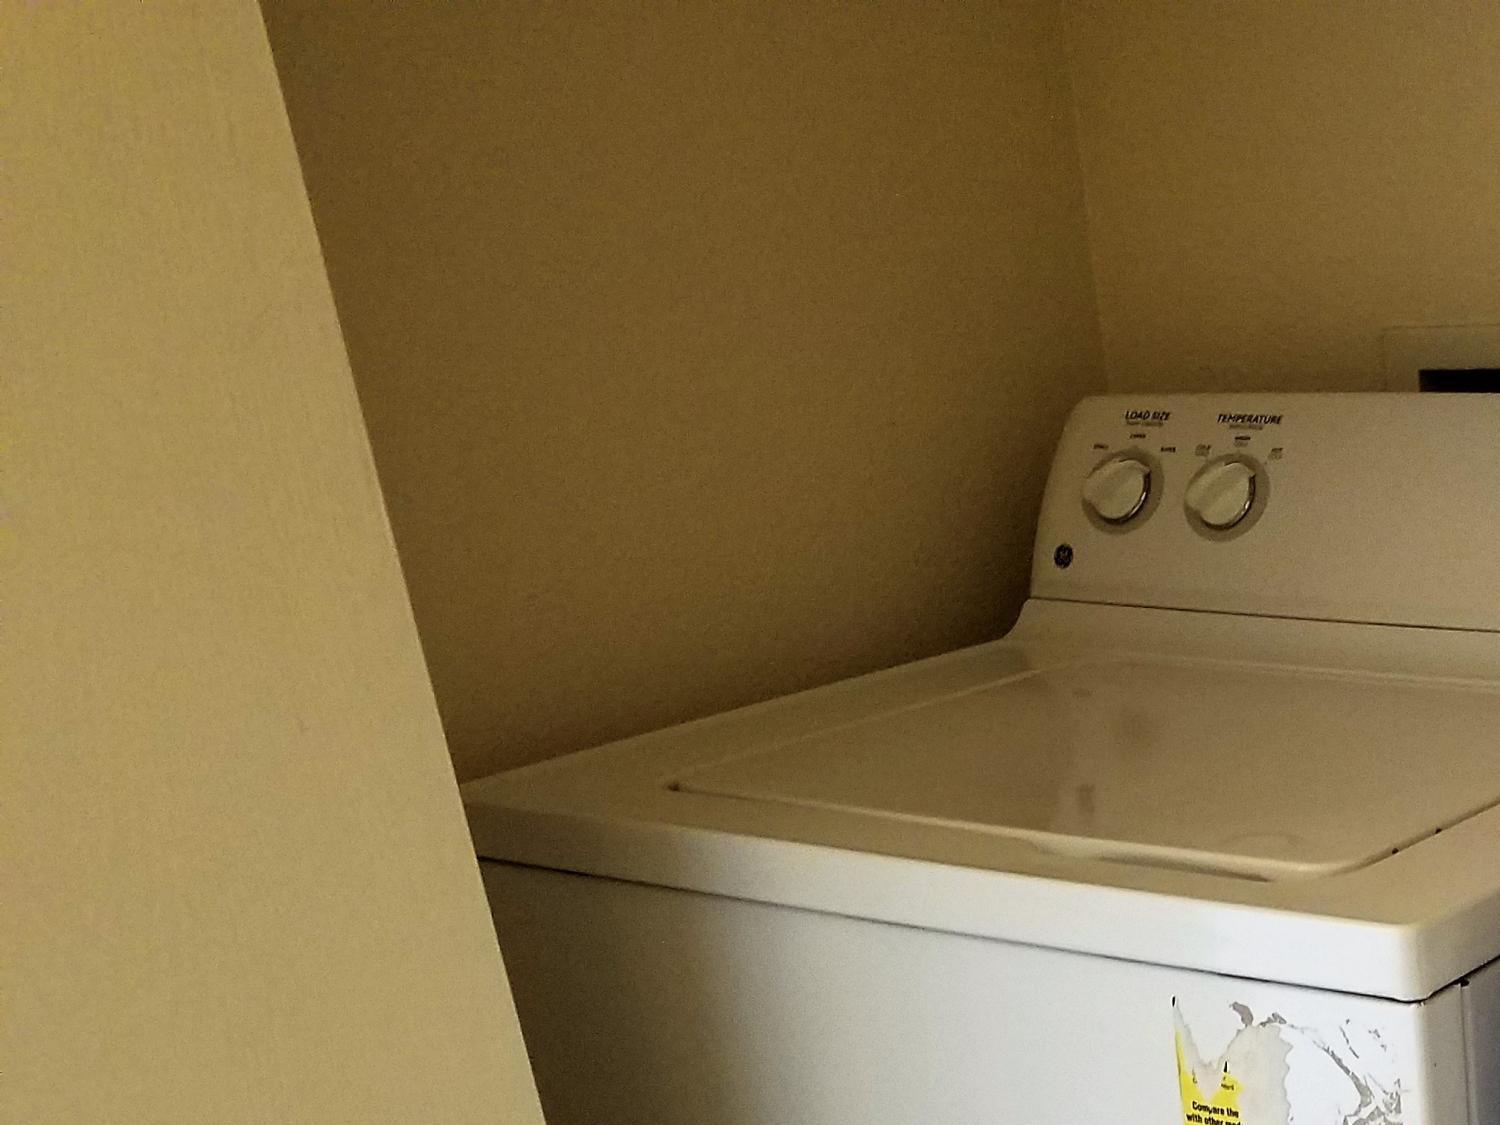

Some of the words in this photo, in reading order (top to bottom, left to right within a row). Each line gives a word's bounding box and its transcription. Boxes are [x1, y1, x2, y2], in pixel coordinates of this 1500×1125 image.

[1125, 410, 1150, 420] LOAD
[1152, 411, 1170, 421] SIZE
[1217, 413, 1283, 425] TEMPERATURE
[1192, 1100, 1225, 1115] Compare
[1186, 1113, 1203, 1124] with
